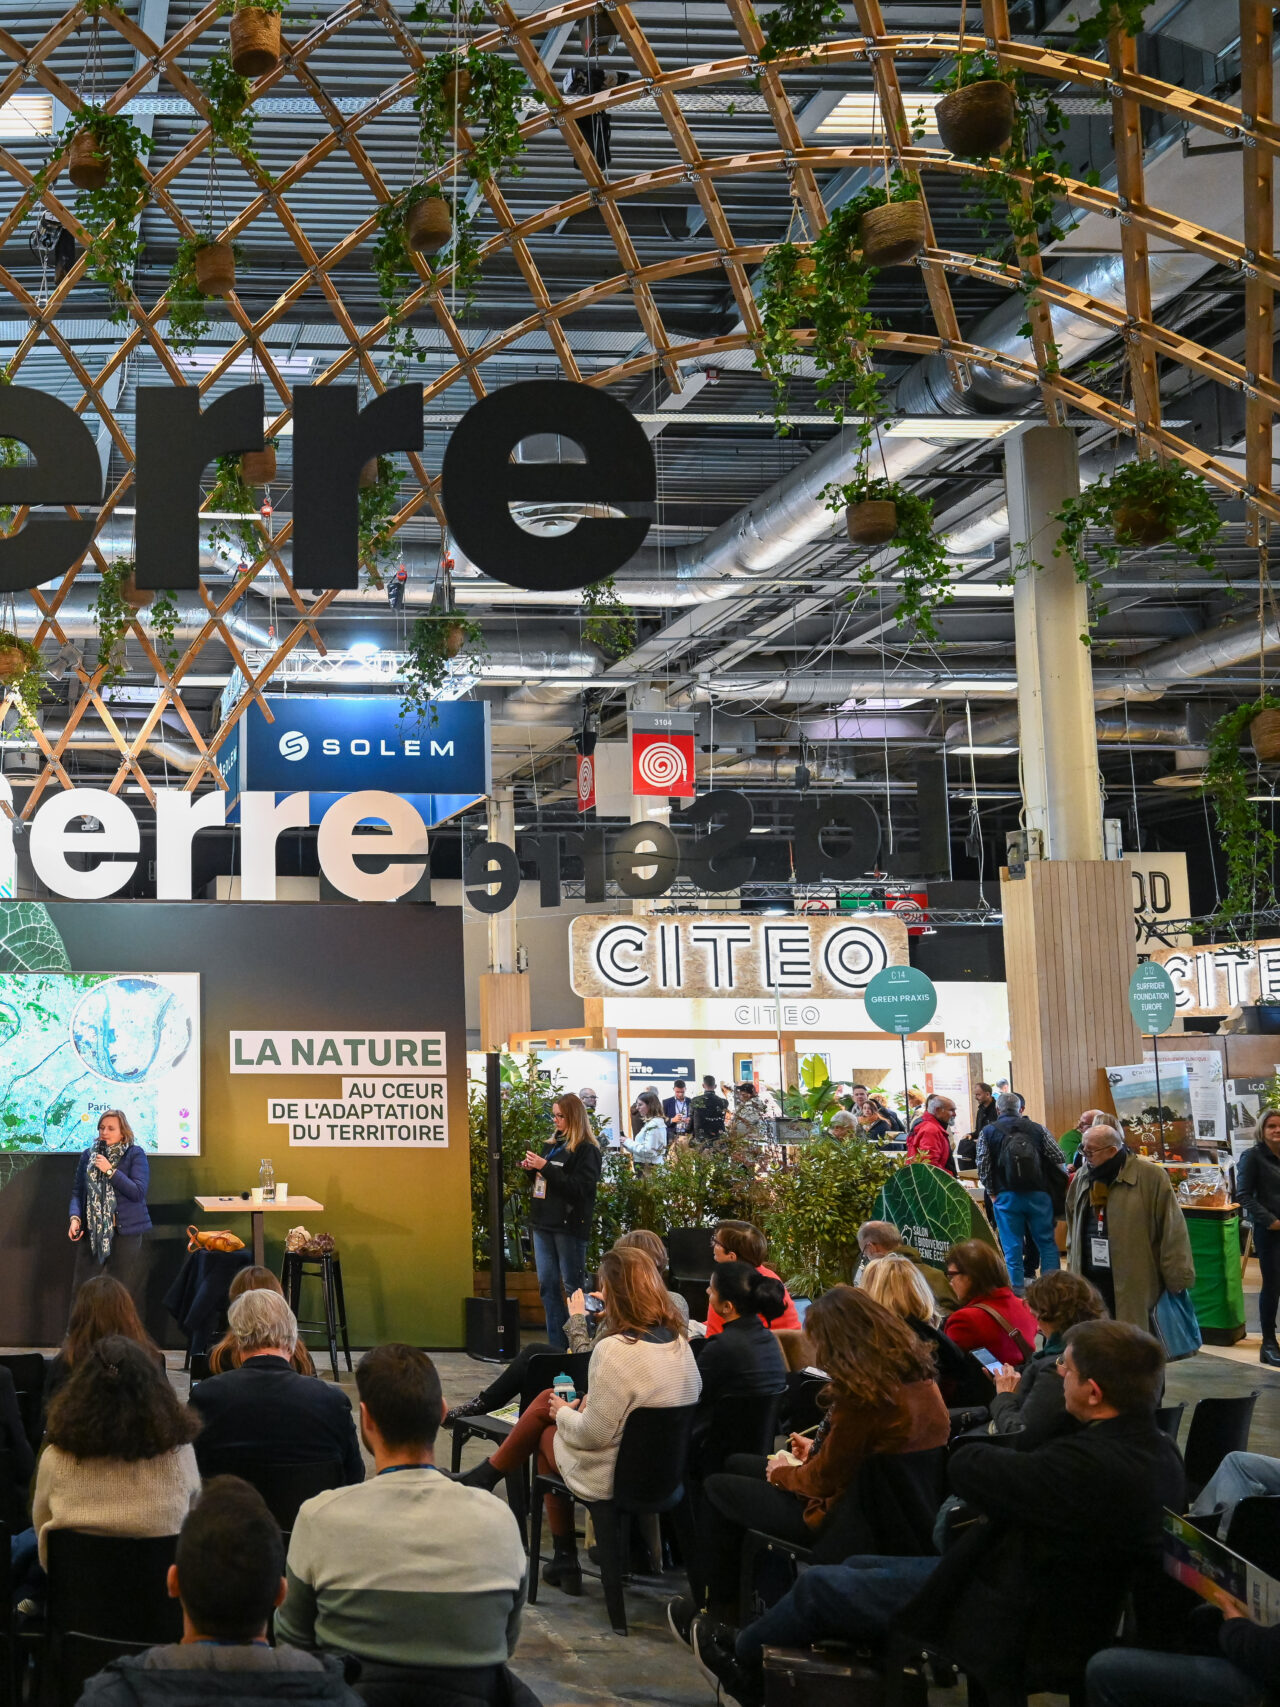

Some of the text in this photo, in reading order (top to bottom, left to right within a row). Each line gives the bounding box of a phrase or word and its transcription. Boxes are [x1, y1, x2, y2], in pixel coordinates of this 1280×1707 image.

[322, 738, 455, 756] SOLEM
[596, 925, 888, 989] CITEO
[1136, 981, 1165, 990] SURFRIDER
[900, 993, 930, 1002] PRAXIS
[1133, 992, 1169, 1000] FOUNDATION
[1141, 1002, 1162, 1011] EUROPE
[734, 1005, 821, 1026] CITEO
[945, 1039, 971, 1050] PRO
[234, 1038, 443, 1067] LA NATURE
[348, 1083, 444, 1099] AU CŒUR
[87, 1102, 111, 1112] Paris
[272, 1103, 444, 1120] DE L'ADAPTATION
[293, 1124, 445, 1141] DU TERRITOIRE
[913, 1225, 928, 1237] SALON
